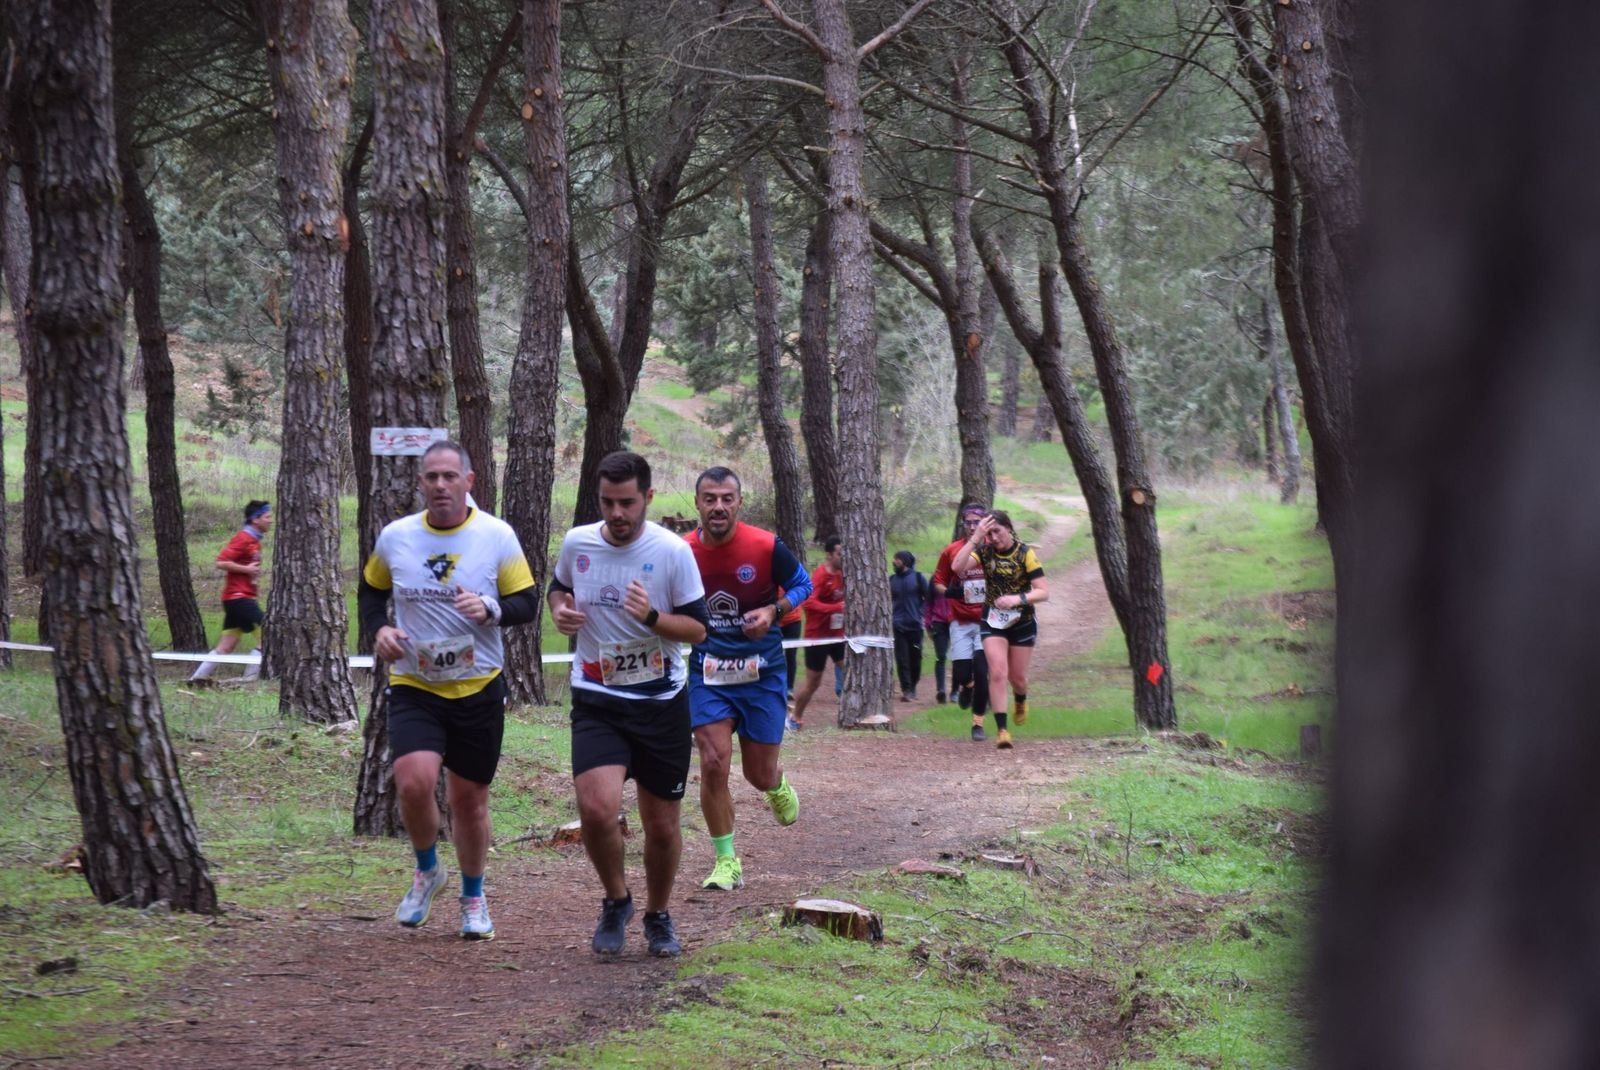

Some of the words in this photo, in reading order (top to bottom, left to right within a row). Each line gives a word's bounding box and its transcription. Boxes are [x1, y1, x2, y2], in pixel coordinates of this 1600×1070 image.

[999, 613, 1009, 622] 30
[434, 651, 455, 667] 40
[615, 652, 648, 672] 221
[716, 657, 746, 672] 220
